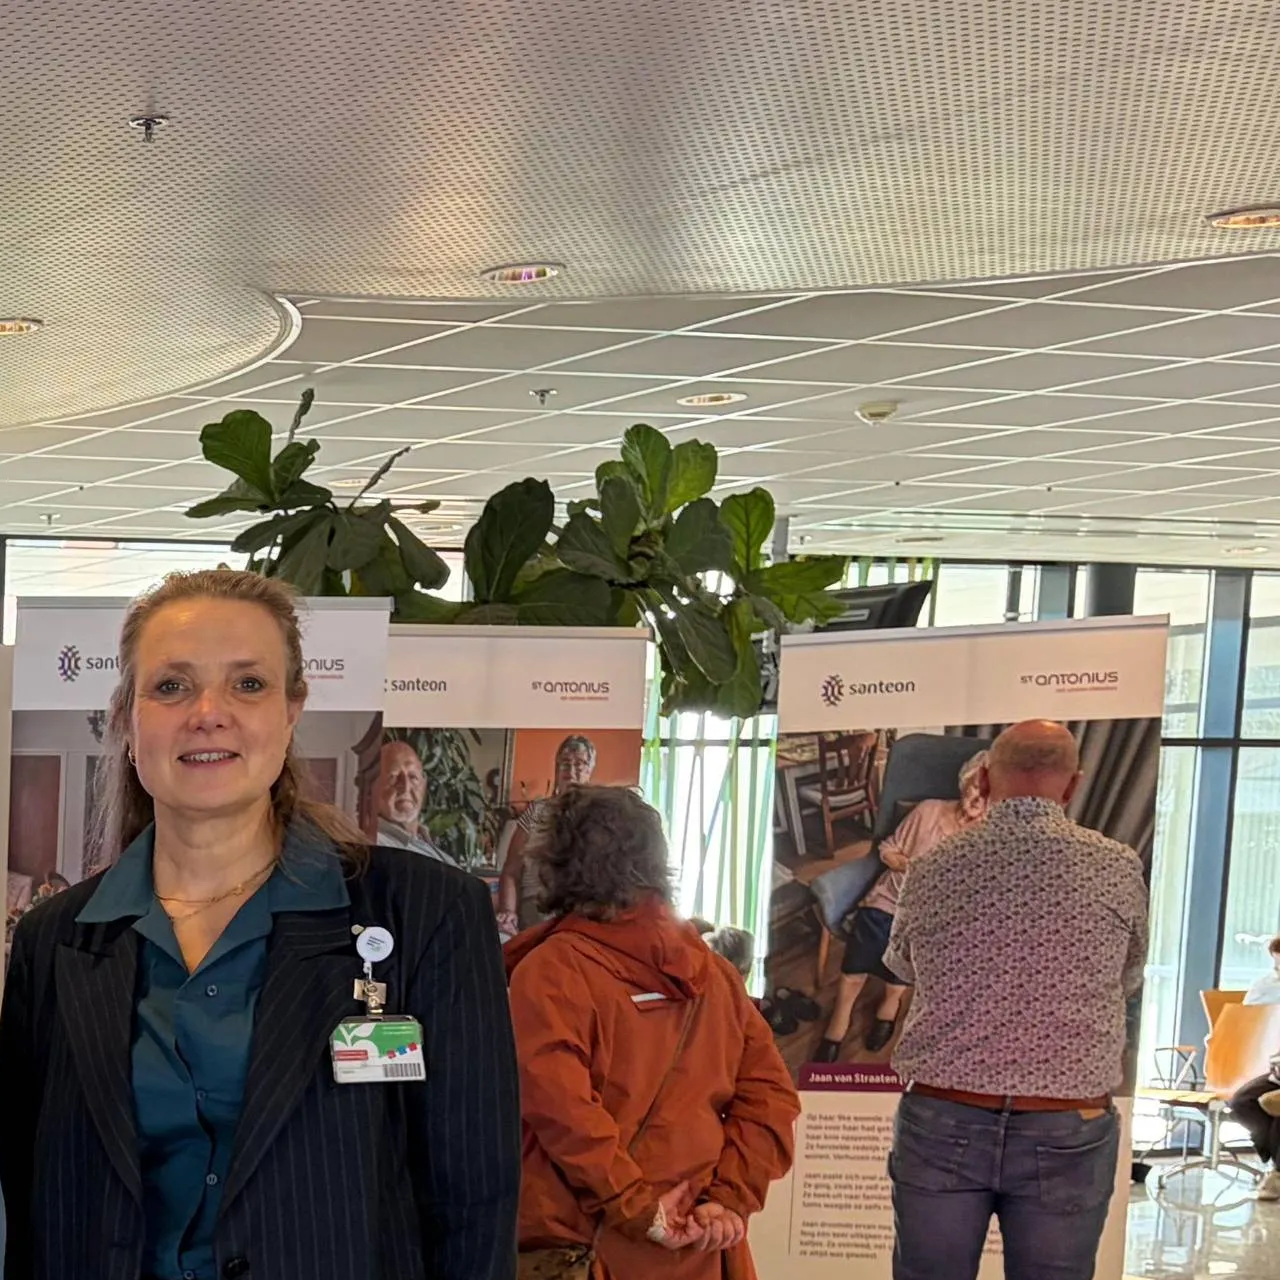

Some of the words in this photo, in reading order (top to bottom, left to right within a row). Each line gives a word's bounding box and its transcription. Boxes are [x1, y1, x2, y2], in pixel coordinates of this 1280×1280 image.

[391, 678, 447, 692] santeon
[848, 680, 915, 696] santeon
[808, 1073, 833, 1083] Jaan
[835, 1074, 852, 1083] van
[854, 1073, 898, 1083] Straaten
